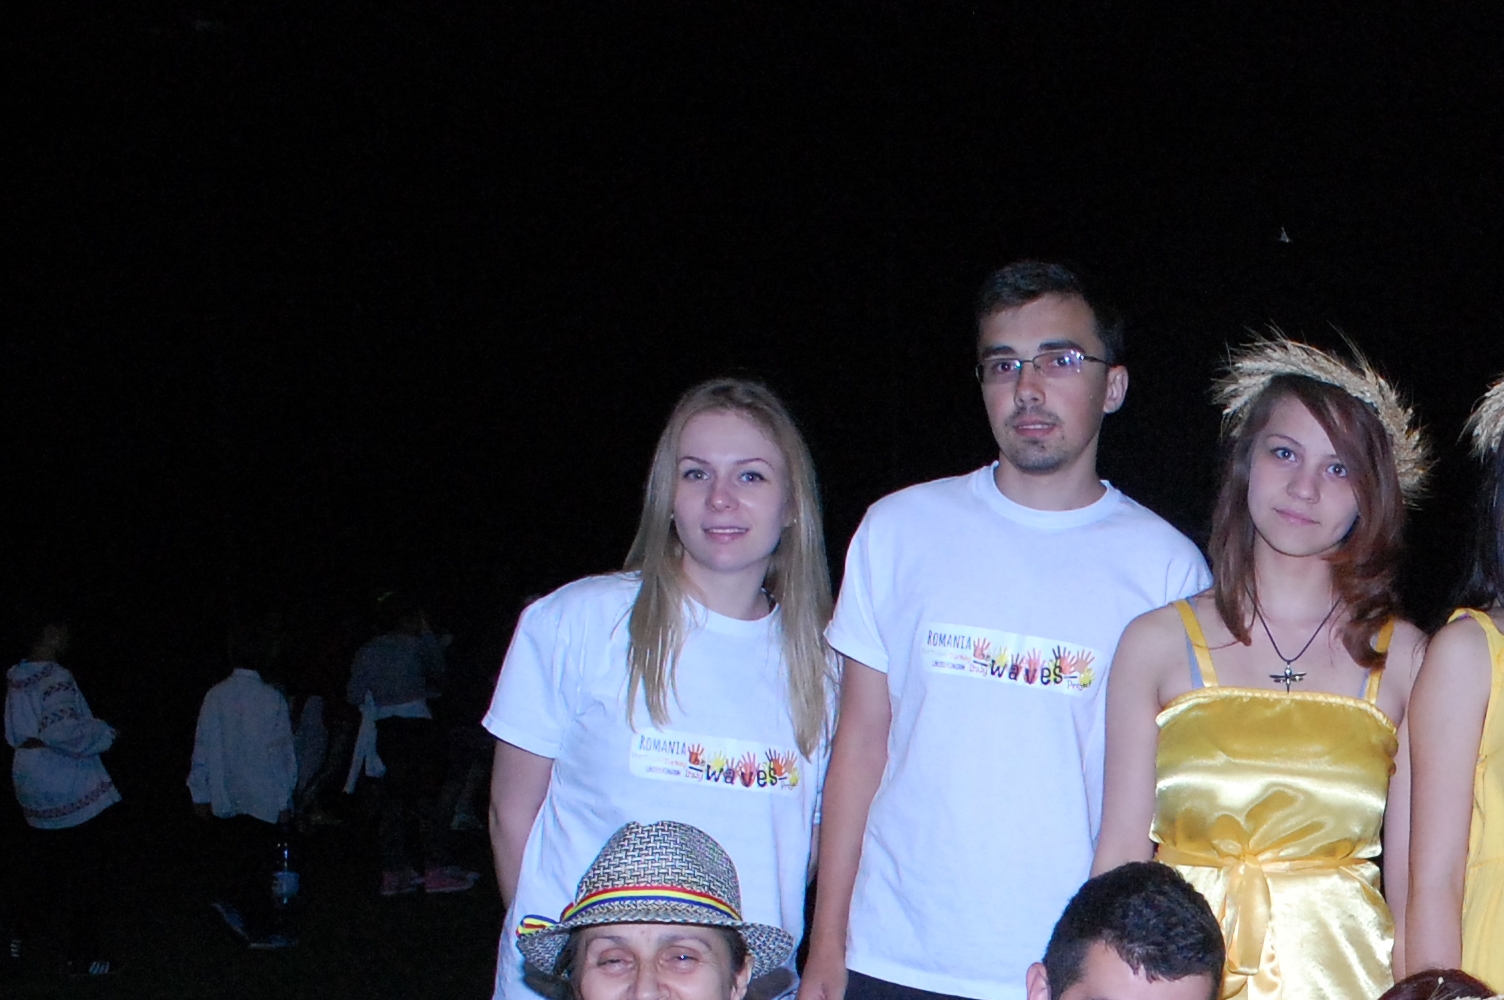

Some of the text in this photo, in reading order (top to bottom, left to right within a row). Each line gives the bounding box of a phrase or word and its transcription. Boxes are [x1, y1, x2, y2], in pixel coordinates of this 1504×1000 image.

[927, 630, 972, 650] ROMANIA
[990, 659, 1063, 686] waves
[639, 734, 687, 756] ROMANIA
[706, 763, 778, 788] waves
